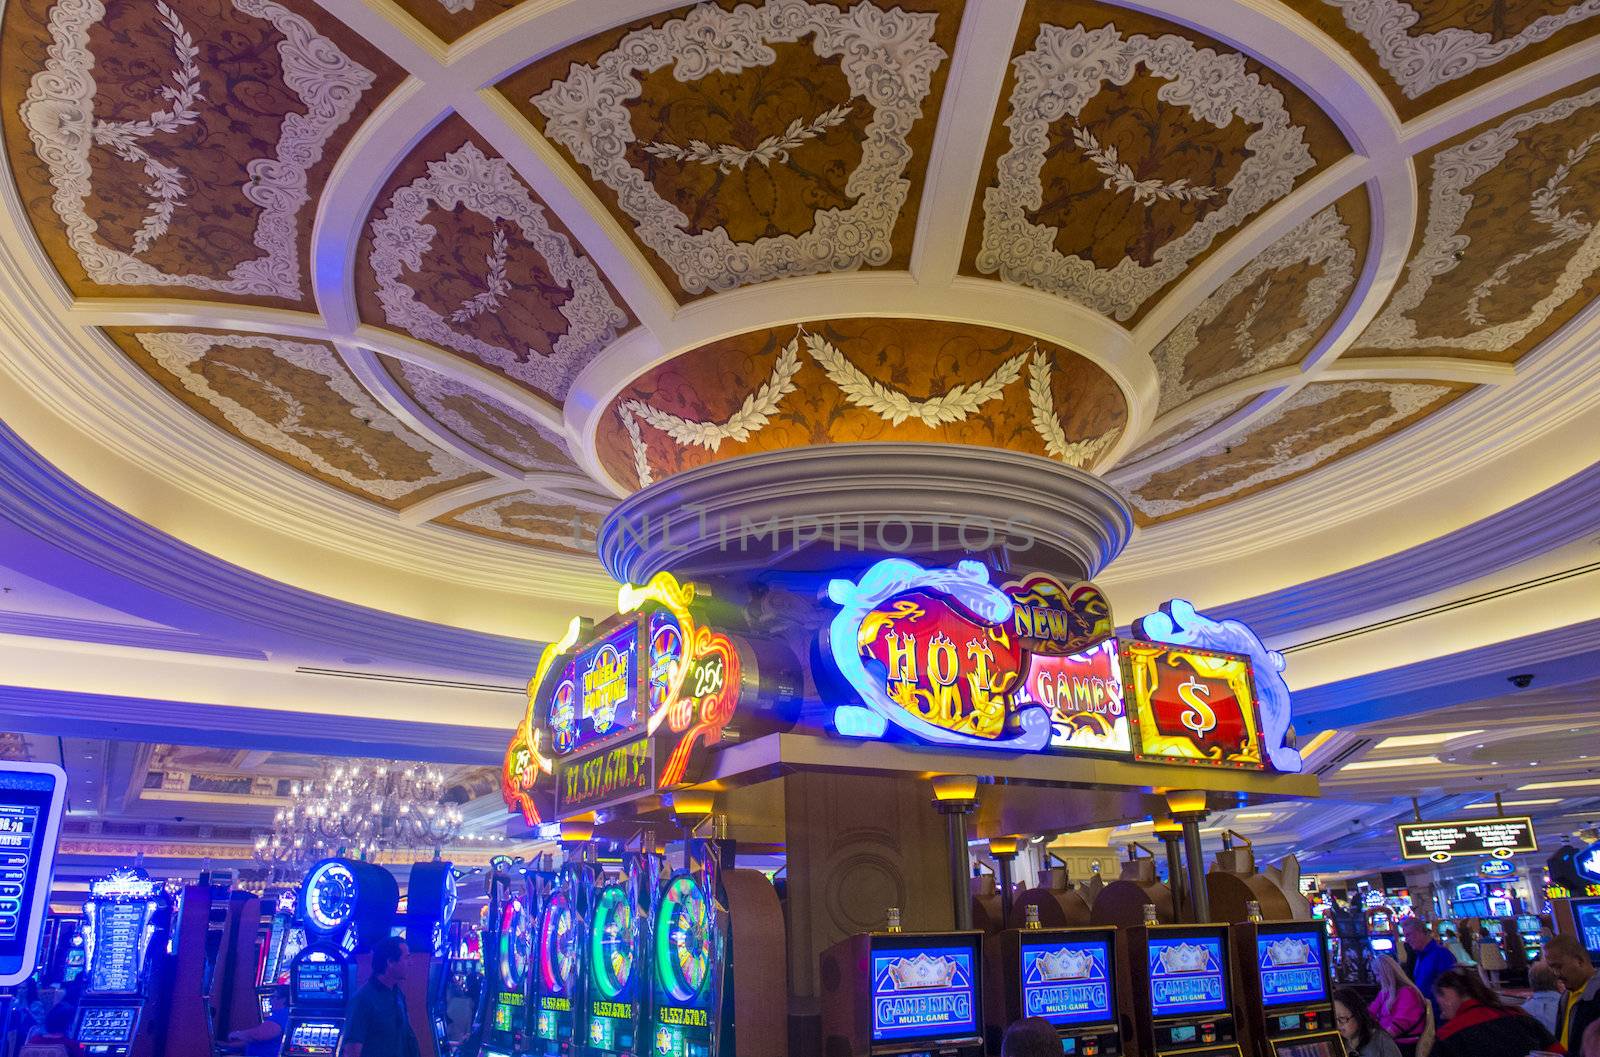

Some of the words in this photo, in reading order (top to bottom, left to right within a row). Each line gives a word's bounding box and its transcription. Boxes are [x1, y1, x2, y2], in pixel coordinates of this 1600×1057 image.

[1013, 603, 1068, 642] NEW
[885, 629, 995, 690] HOT
[585, 677, 627, 715] FORTUNE
[1038, 671, 1122, 715] GAMES
[1154, 981, 1189, 1003] GAME
[1190, 977, 1221, 999] KING
[1264, 972, 1296, 993] GAME
[878, 998, 927, 1025] GAME
[928, 994, 970, 1019] KING
[1028, 988, 1069, 1013] GAME
[1071, 985, 1106, 1008] KING
[1046, 1003, 1089, 1013] MULTI-GAME
[899, 1013, 950, 1024] MULTI-GAME
